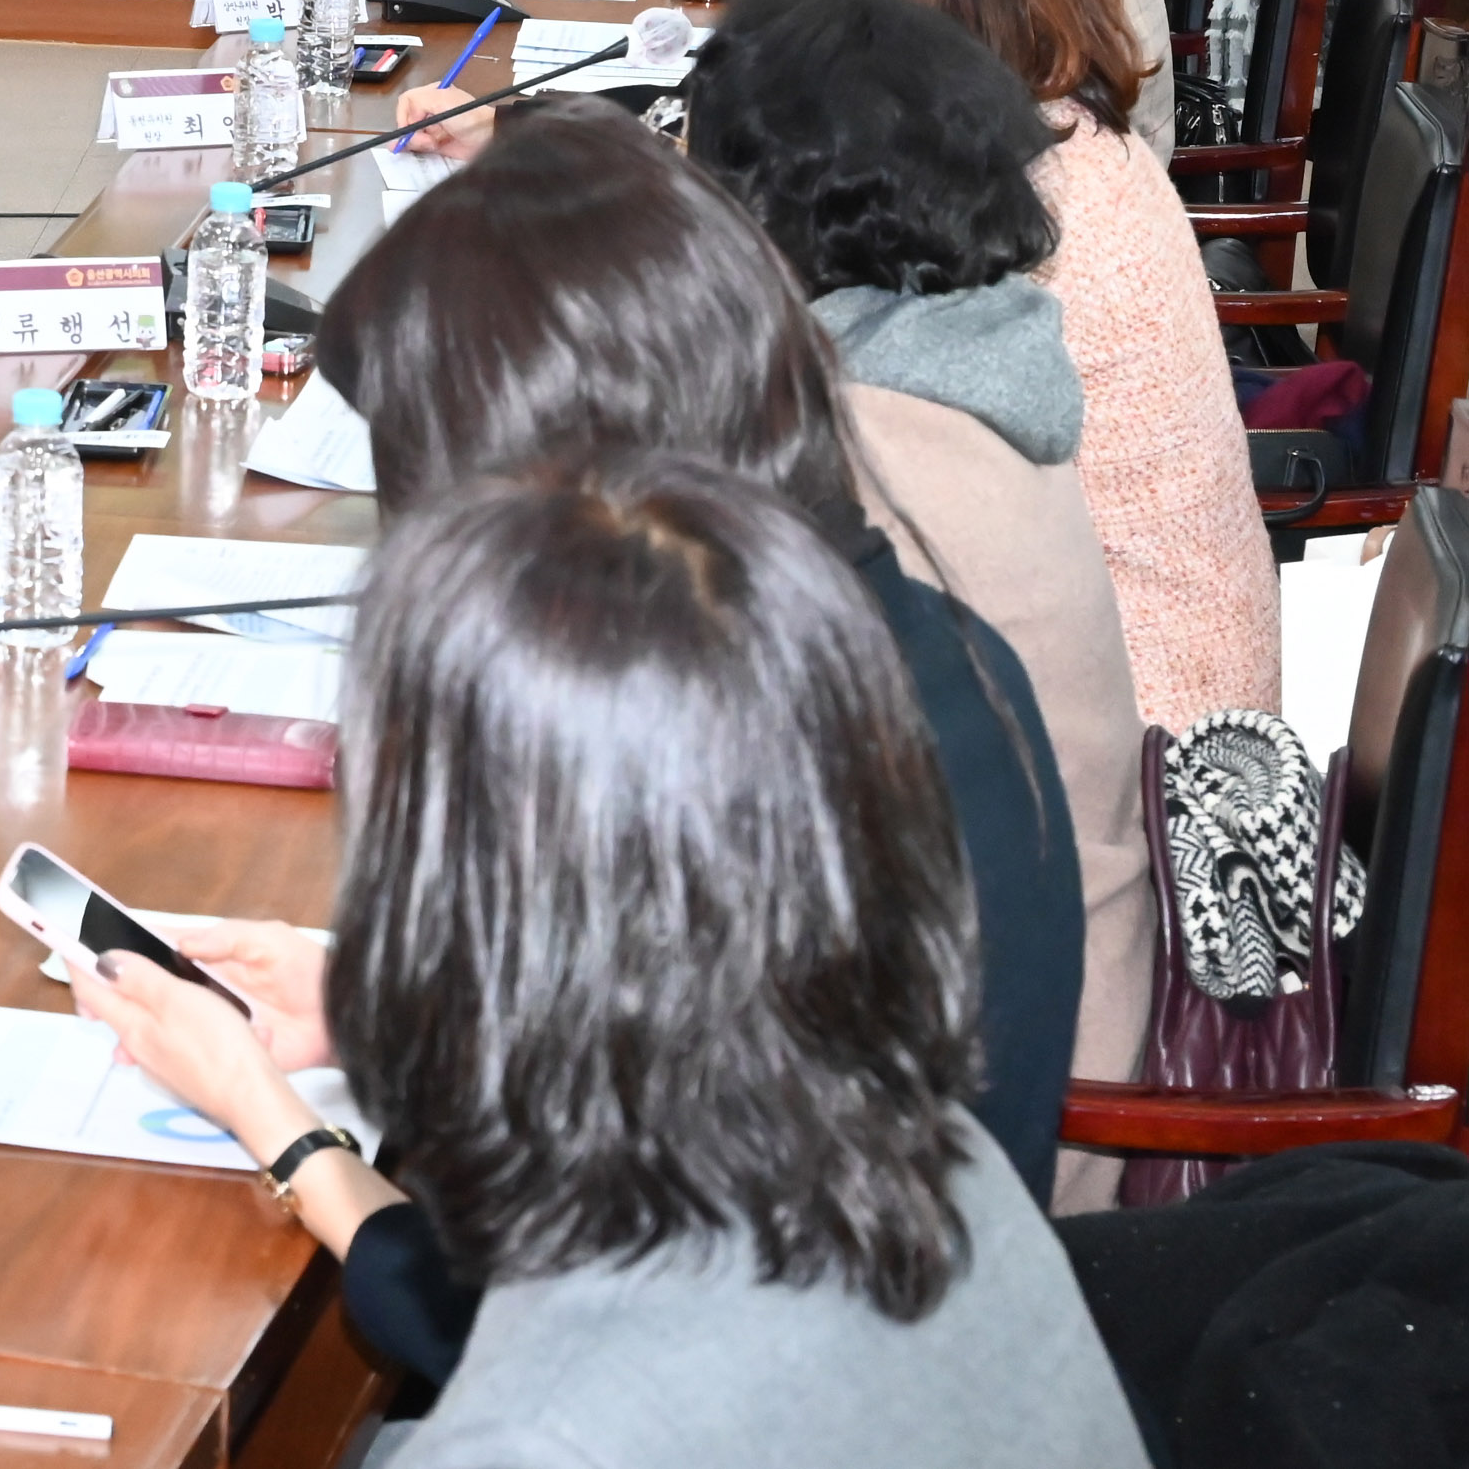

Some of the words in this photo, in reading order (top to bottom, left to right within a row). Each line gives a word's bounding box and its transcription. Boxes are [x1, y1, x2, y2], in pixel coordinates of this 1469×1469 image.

[266, 0, 285, 20] 박
[183, 113, 203, 140] 최
[13, 313, 39, 345] 류
[59, 311, 83, 345] 행
[109, 310, 131, 344] 선
